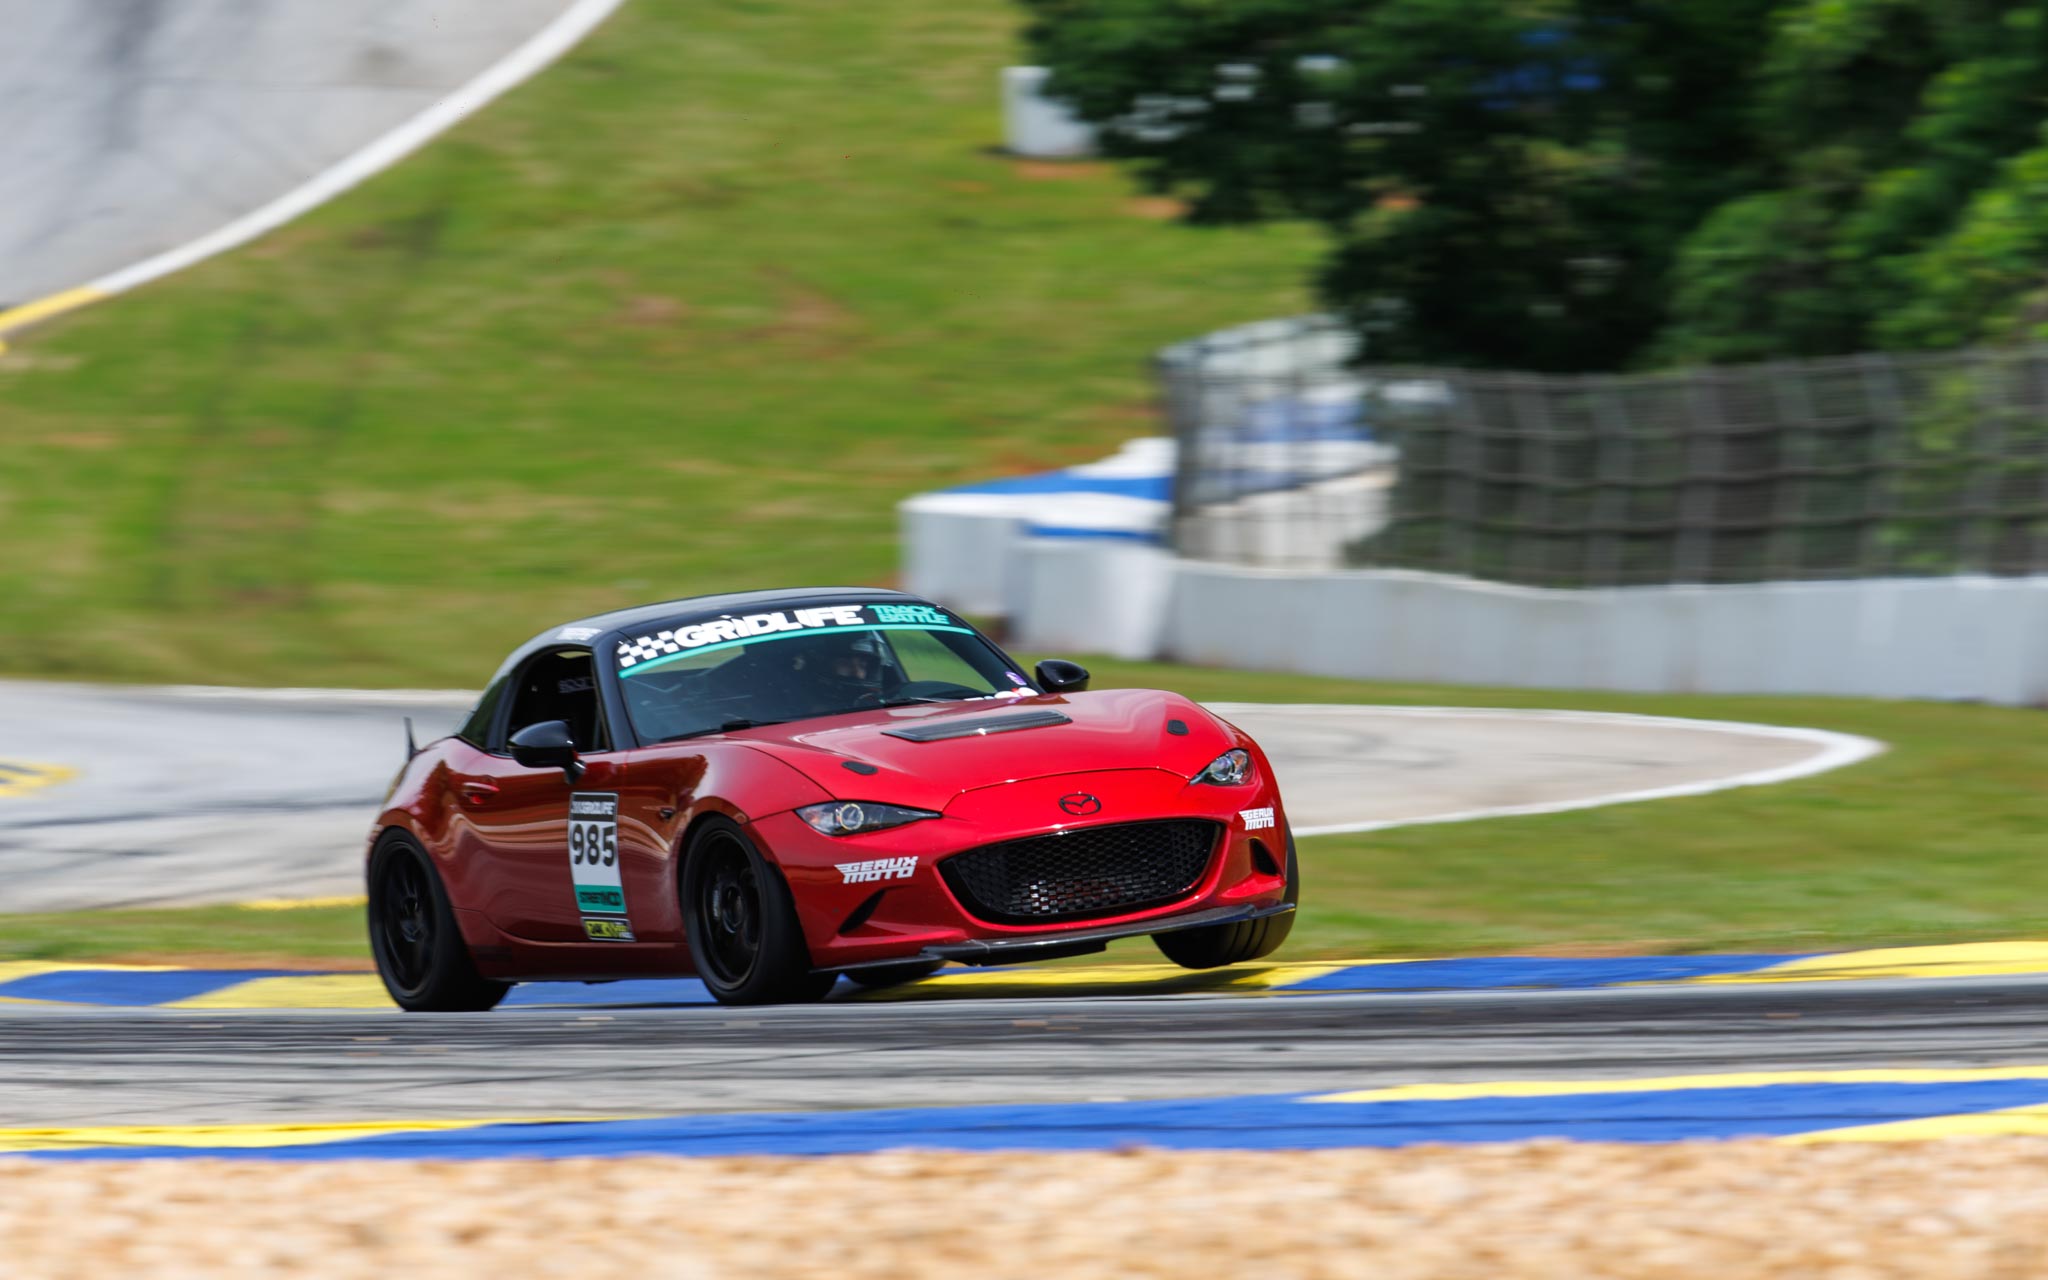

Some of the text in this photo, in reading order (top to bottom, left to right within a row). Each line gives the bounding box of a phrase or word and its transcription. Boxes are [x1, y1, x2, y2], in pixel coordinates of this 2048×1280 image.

[866, 604, 937, 615] TRACK
[879, 612, 951, 625] BATTLE
[673, 605, 865, 648] GRIDLIFE
[1239, 807, 1274, 820] GEAUX
[1244, 817, 1275, 831] MOTO
[572, 823, 616, 867] 985
[834, 856, 919, 873] GEAUX
[842, 866, 916, 885] MOTO
